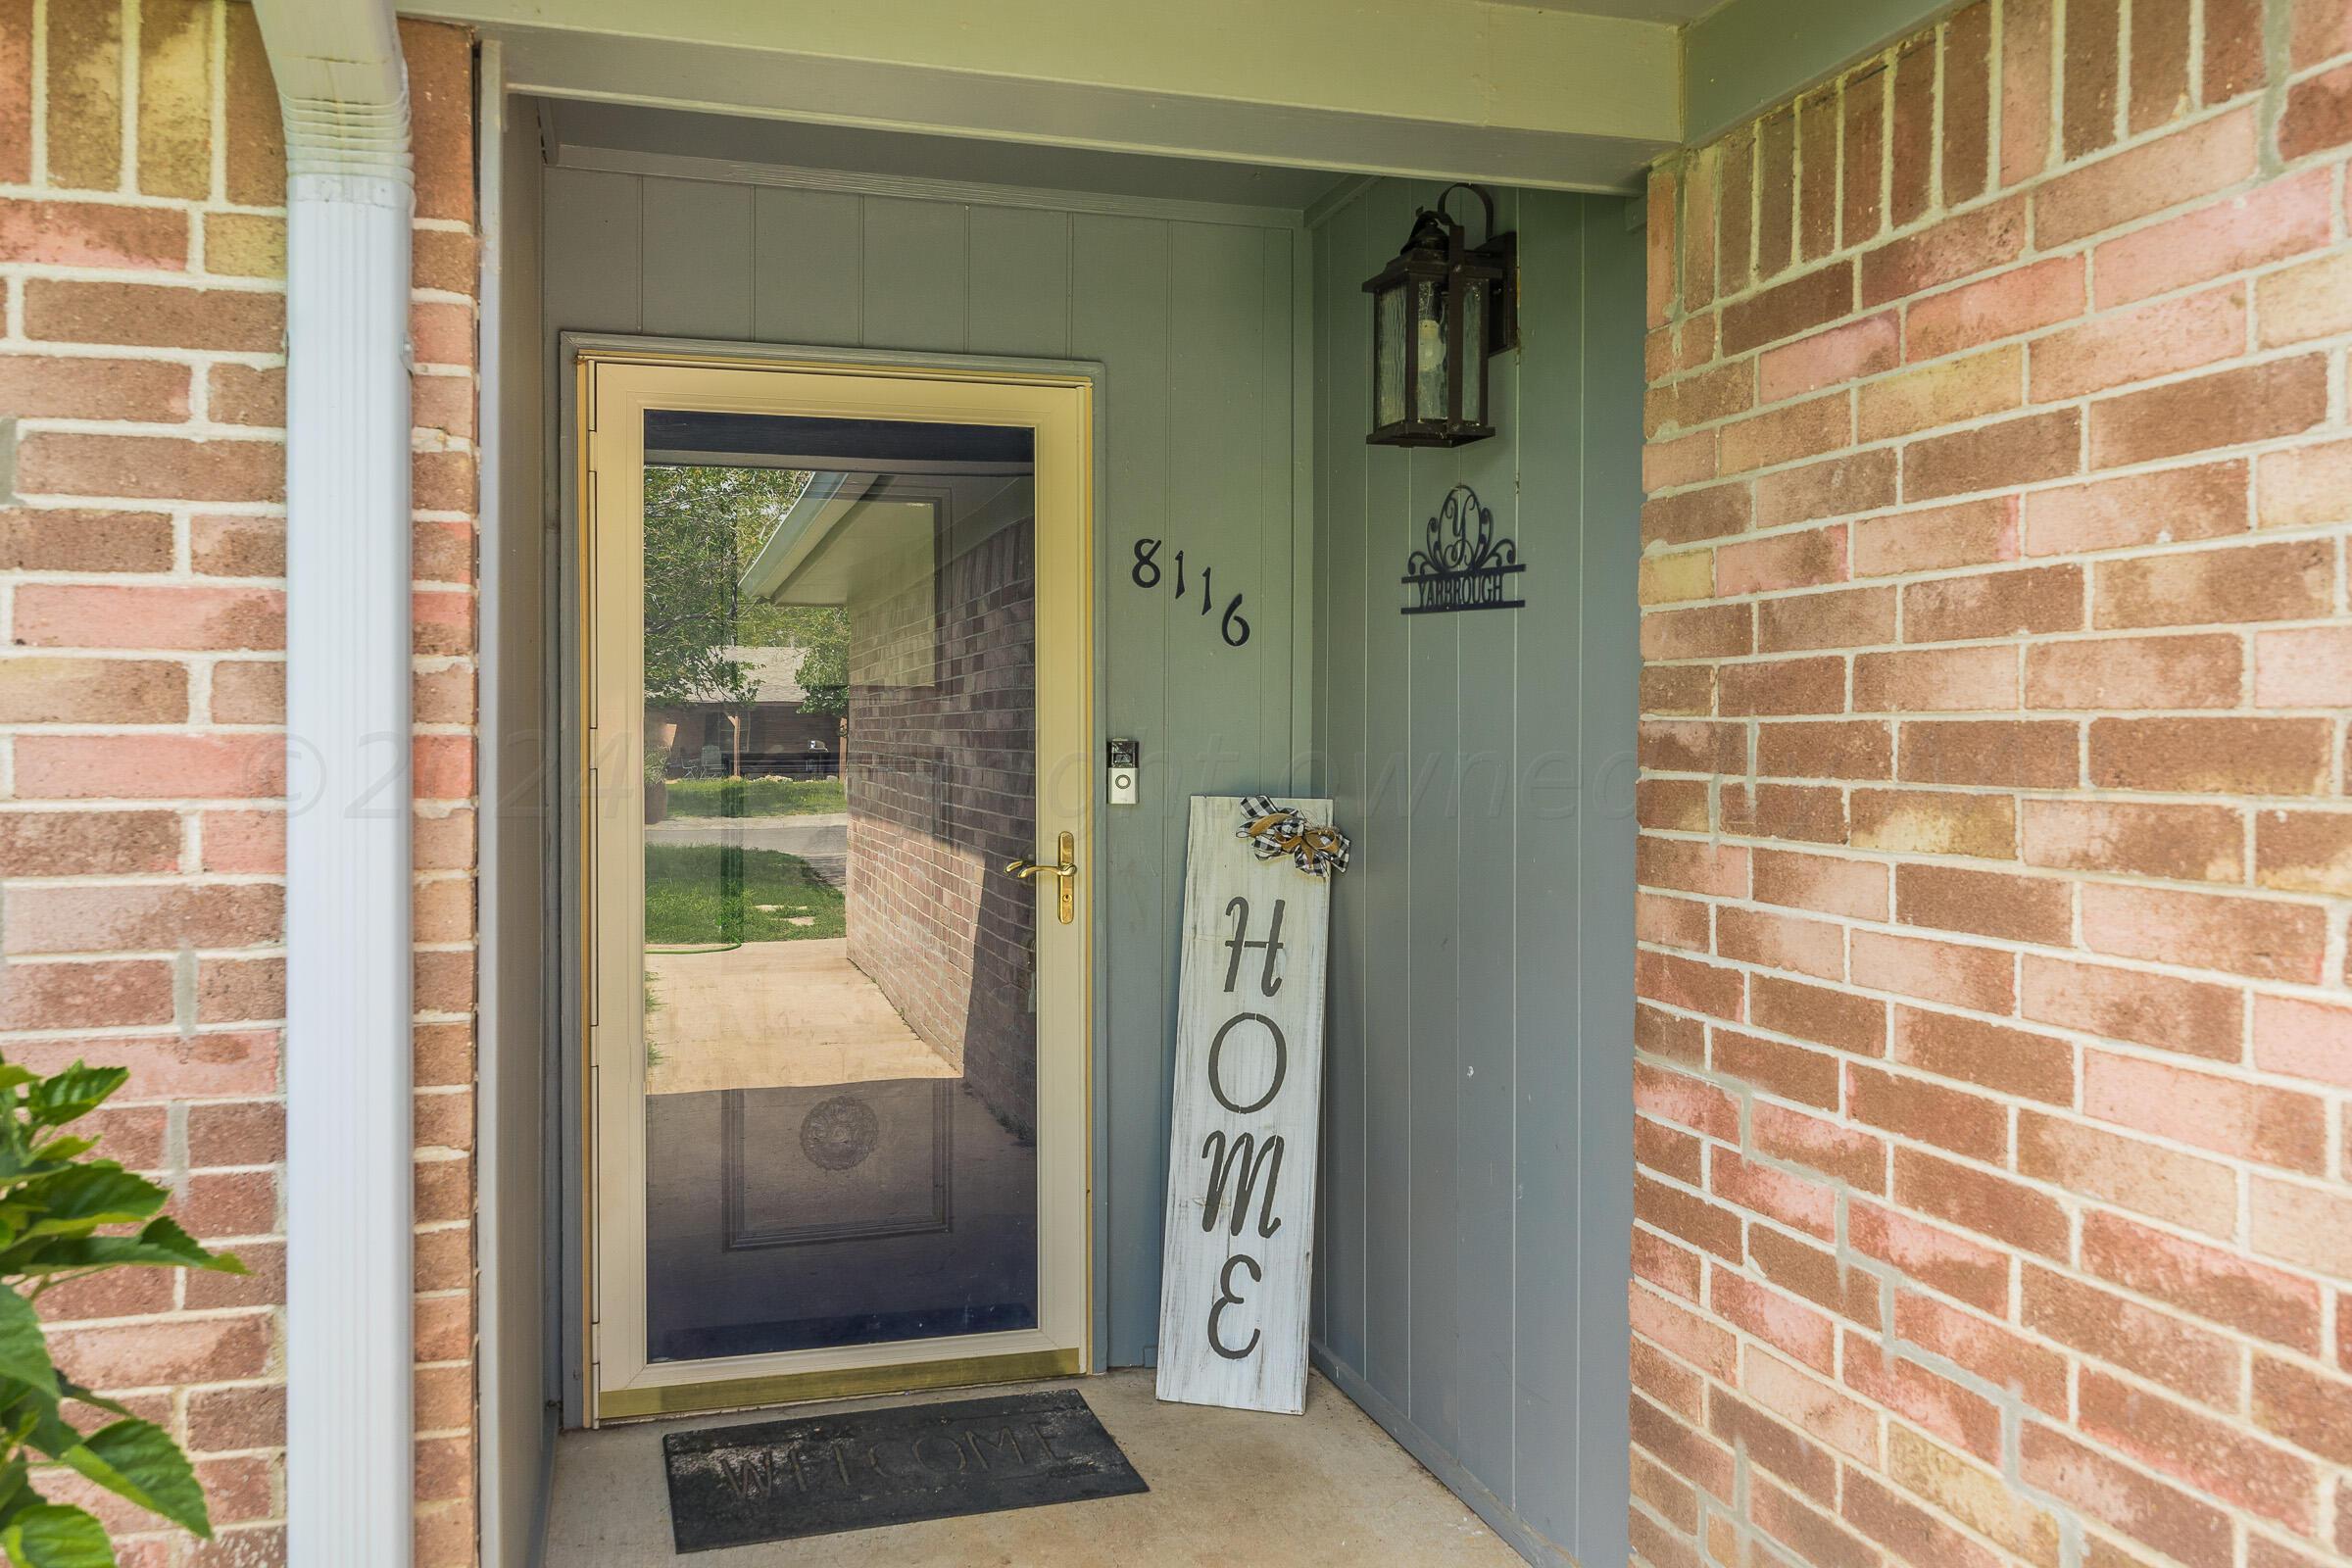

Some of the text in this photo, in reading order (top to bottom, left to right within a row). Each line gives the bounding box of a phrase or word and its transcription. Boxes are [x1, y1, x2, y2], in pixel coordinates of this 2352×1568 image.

[1131, 538, 1251, 647] 8116
[1417, 571, 1504, 610] YARBROUGH
[1201, 895, 1288, 1360] HOME
